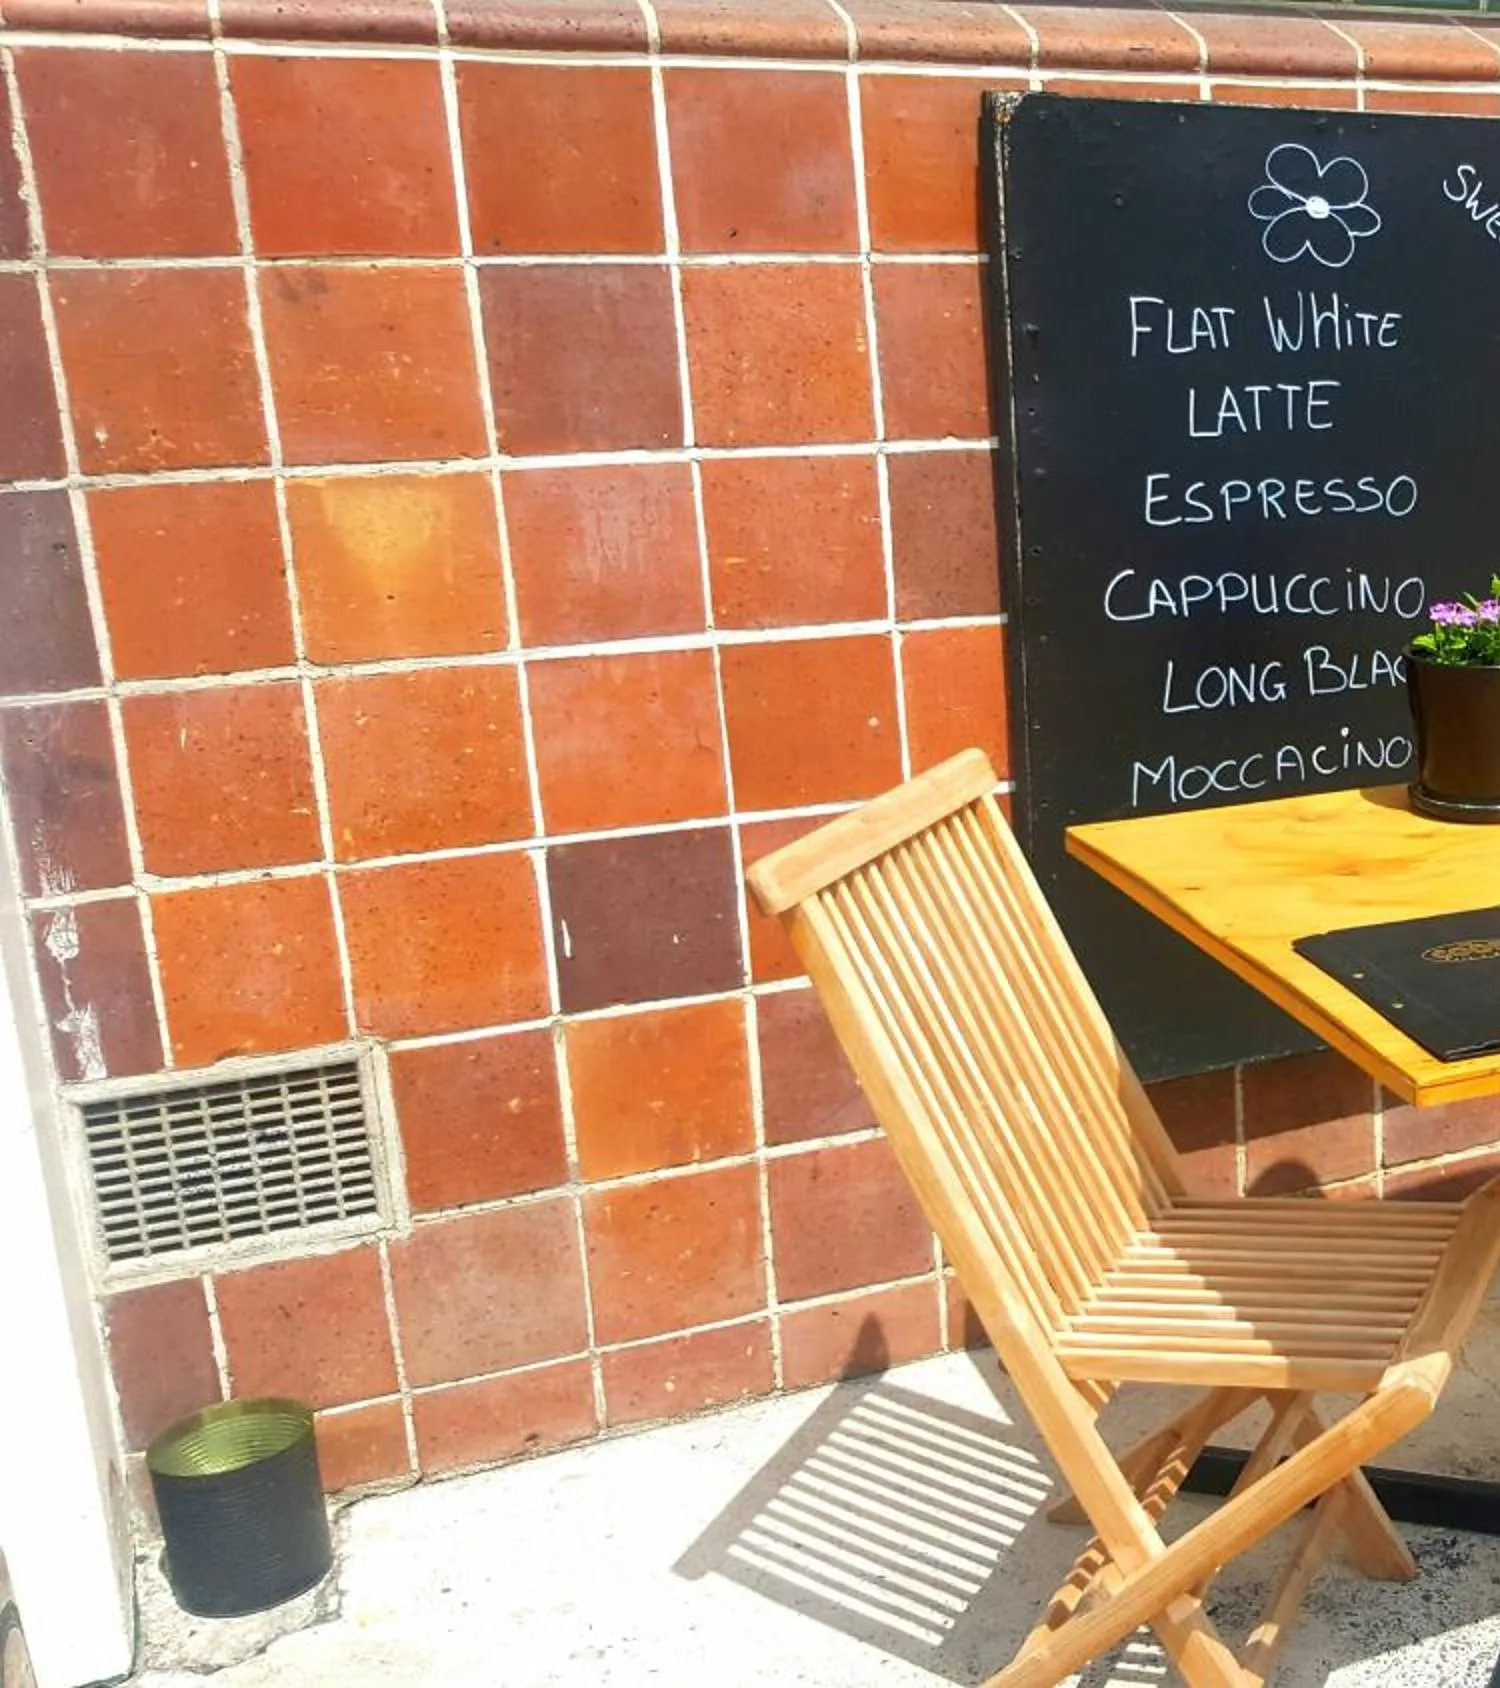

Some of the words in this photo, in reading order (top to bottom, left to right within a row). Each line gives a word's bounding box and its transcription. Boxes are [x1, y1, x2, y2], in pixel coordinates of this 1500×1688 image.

[1129, 296, 1236, 357] FLAT
[1189, 381, 1341, 437] LATTE
[1145, 473, 1418, 527] ESPRESSO
[1163, 660, 1287, 713] LONG
